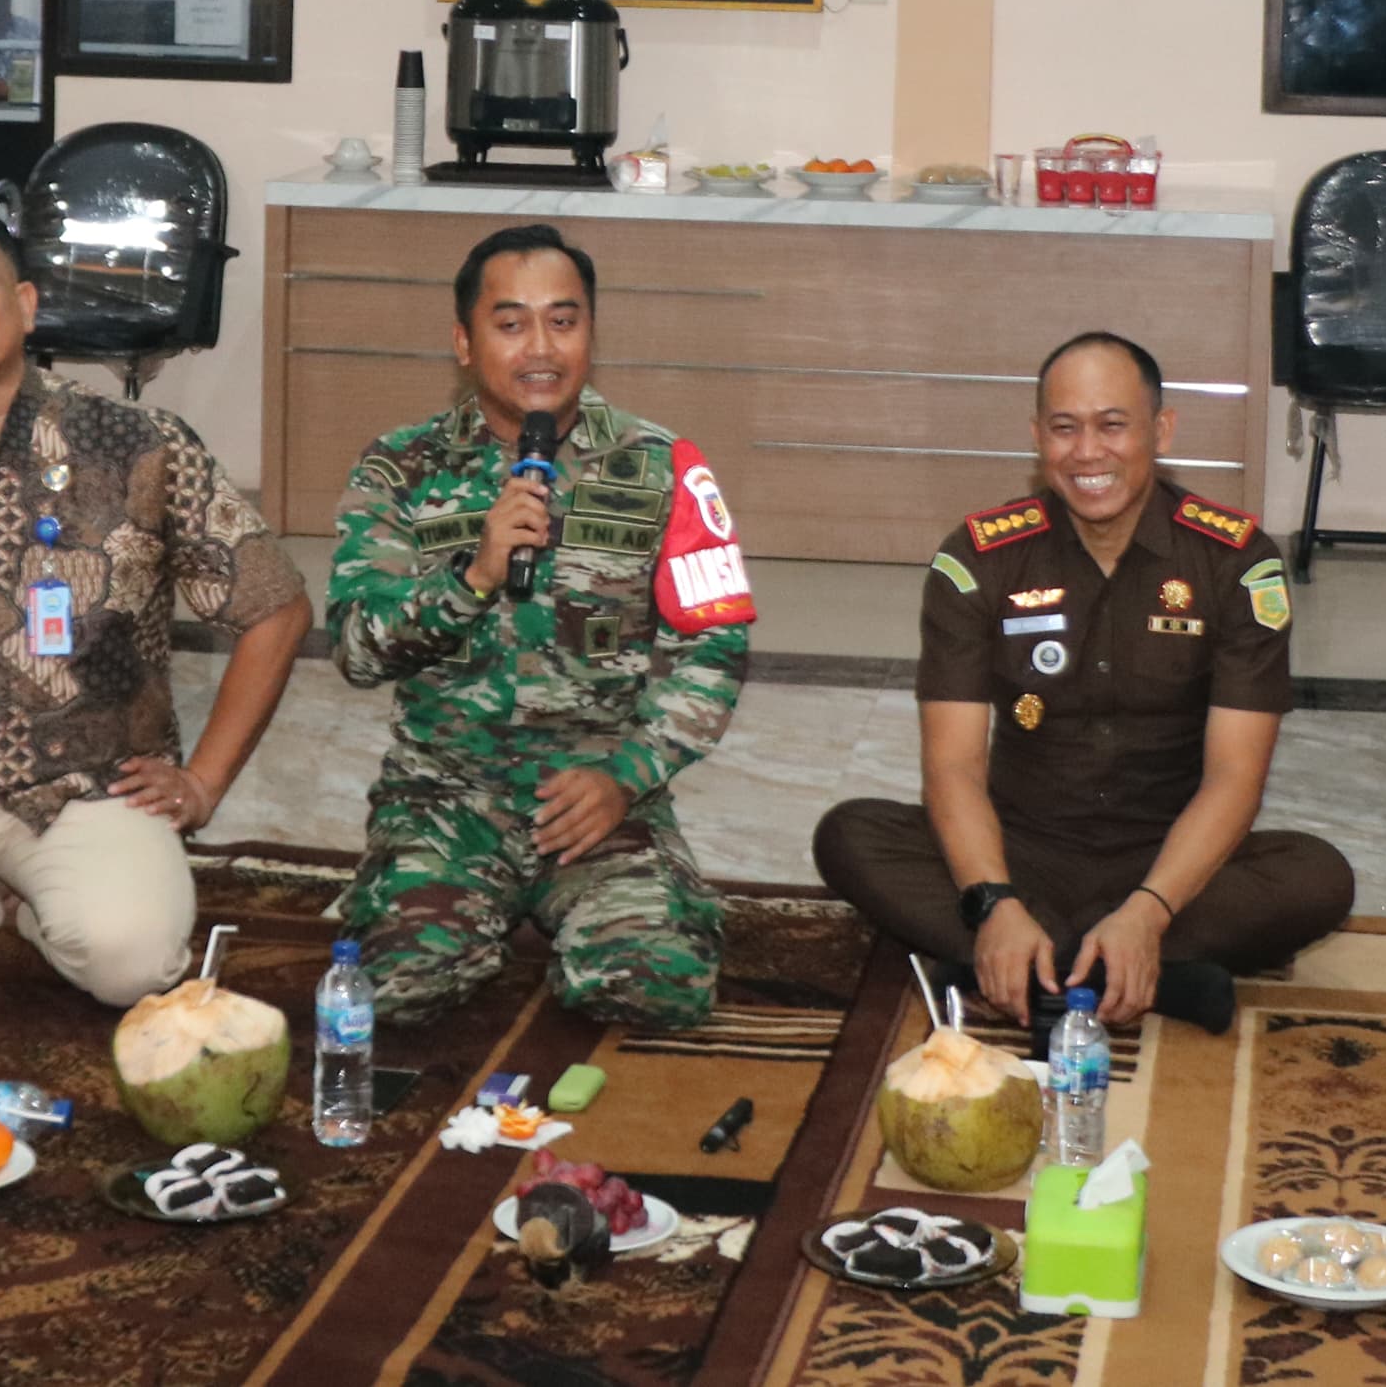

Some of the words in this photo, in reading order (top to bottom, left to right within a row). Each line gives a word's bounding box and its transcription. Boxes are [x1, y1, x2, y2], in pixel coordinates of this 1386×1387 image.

[579, 523, 613, 544] TNI
[622, 525, 649, 546] AD
[668, 544, 750, 609] DANSA
